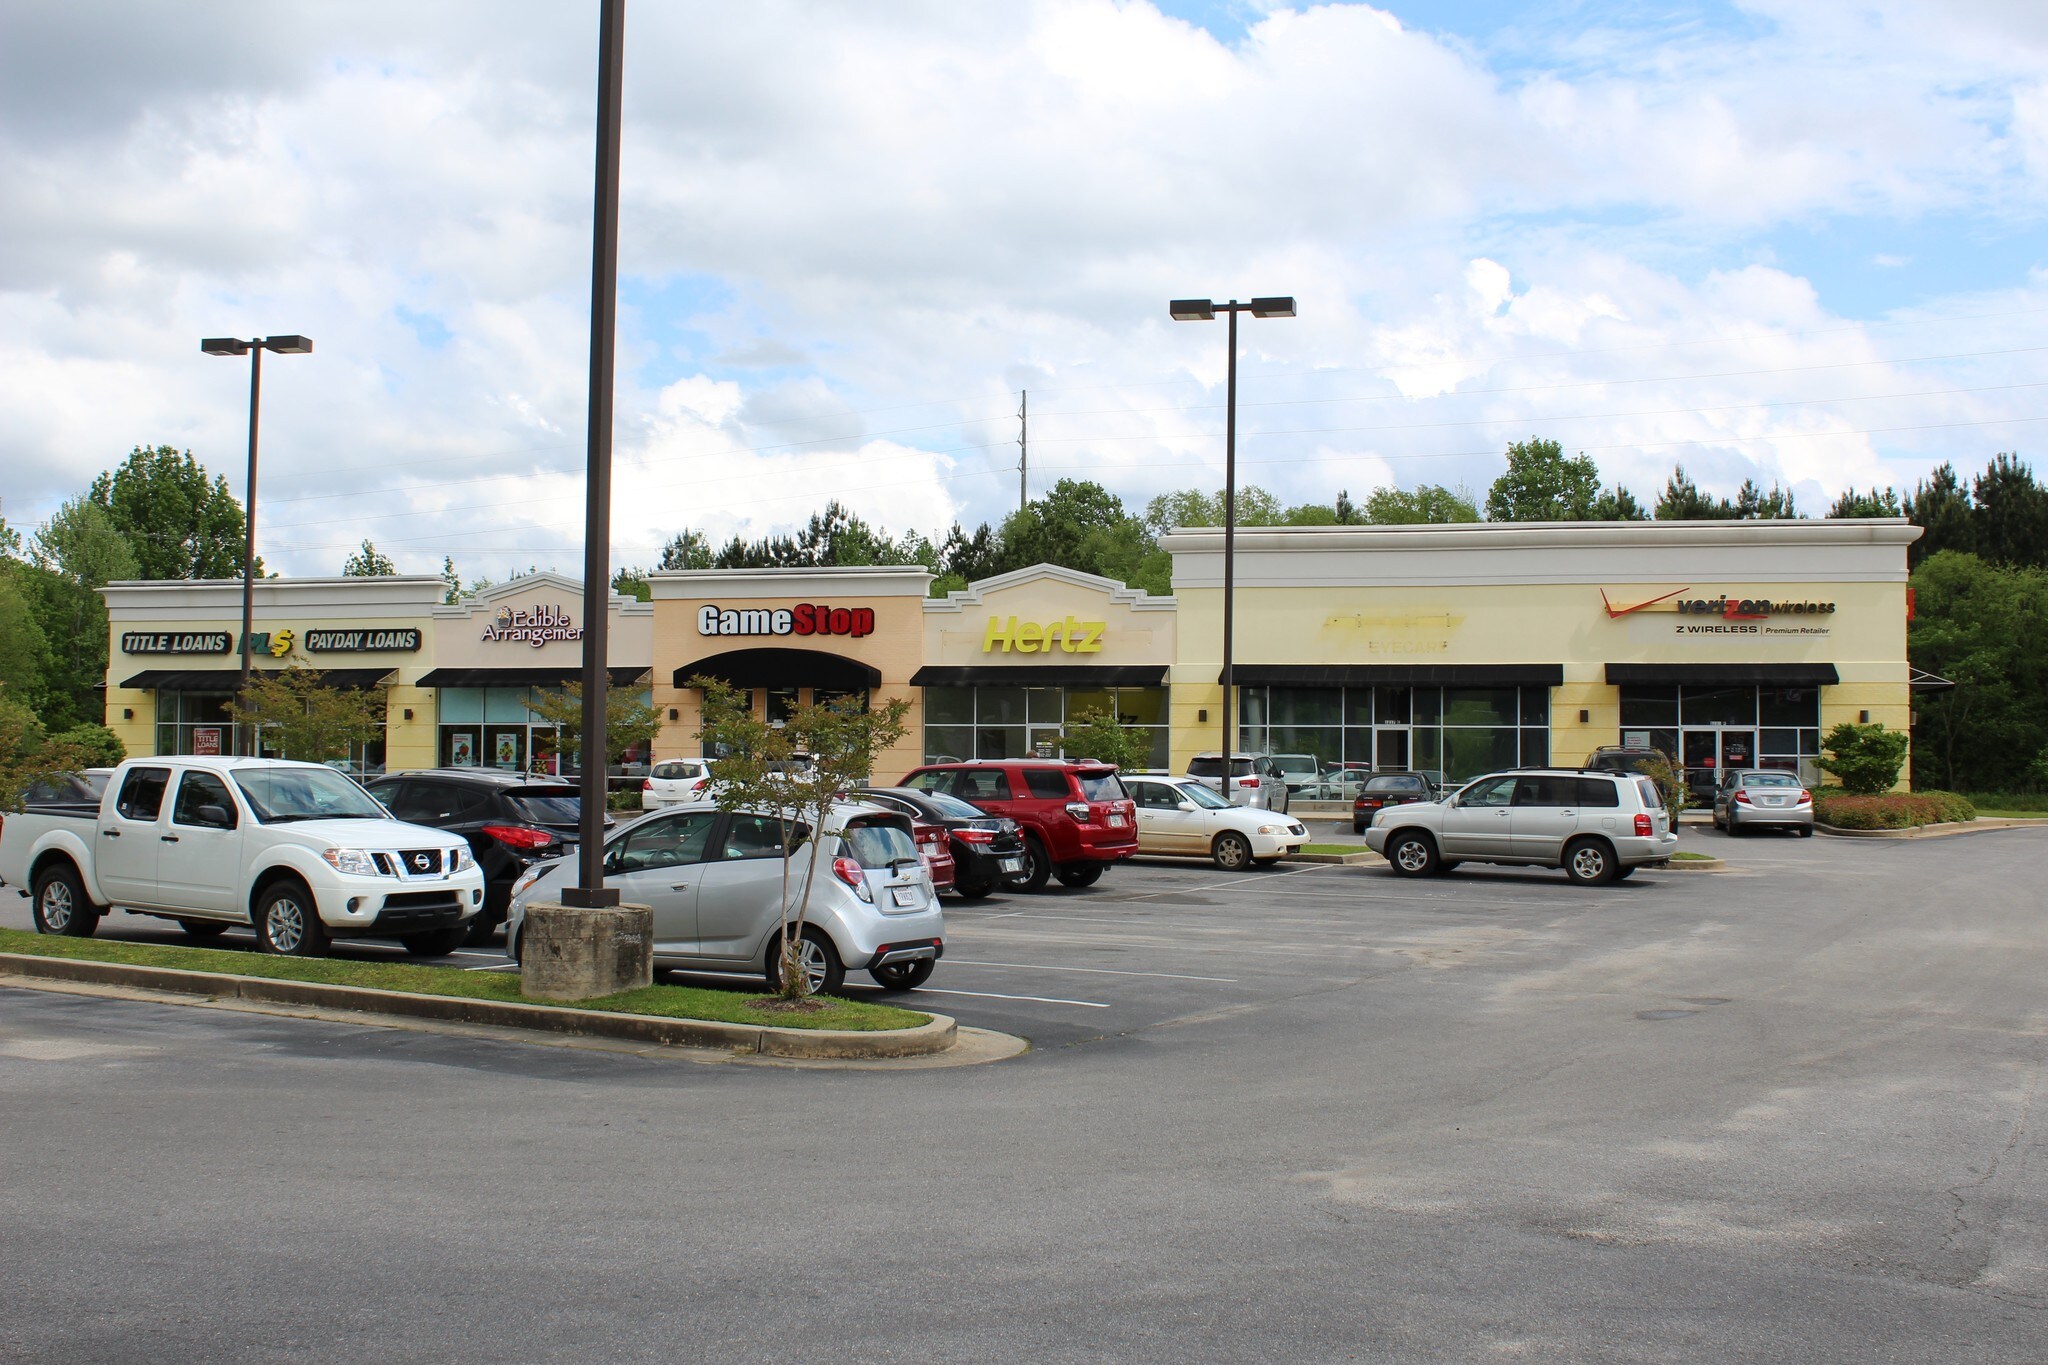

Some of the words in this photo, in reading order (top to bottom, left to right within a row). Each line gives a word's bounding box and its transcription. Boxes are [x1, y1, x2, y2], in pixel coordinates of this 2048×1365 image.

[512, 604, 570, 627] Edible
[697, 603, 875, 638] GameStop
[982, 615, 1107, 653] Hertz
[1676, 625, 1685, 634] Z
[1687, 625, 1758, 634] WIRELESS
[1765, 627, 1799, 635] Premium
[1800, 627, 1830, 635] Retailer
[124, 635, 168, 651] TITLE
[172, 635, 226, 651] LOANS
[308, 633, 363, 649] PAYDAY
[366, 632, 416, 648] LOANS
[1369, 640, 1449, 654] EYECARE
